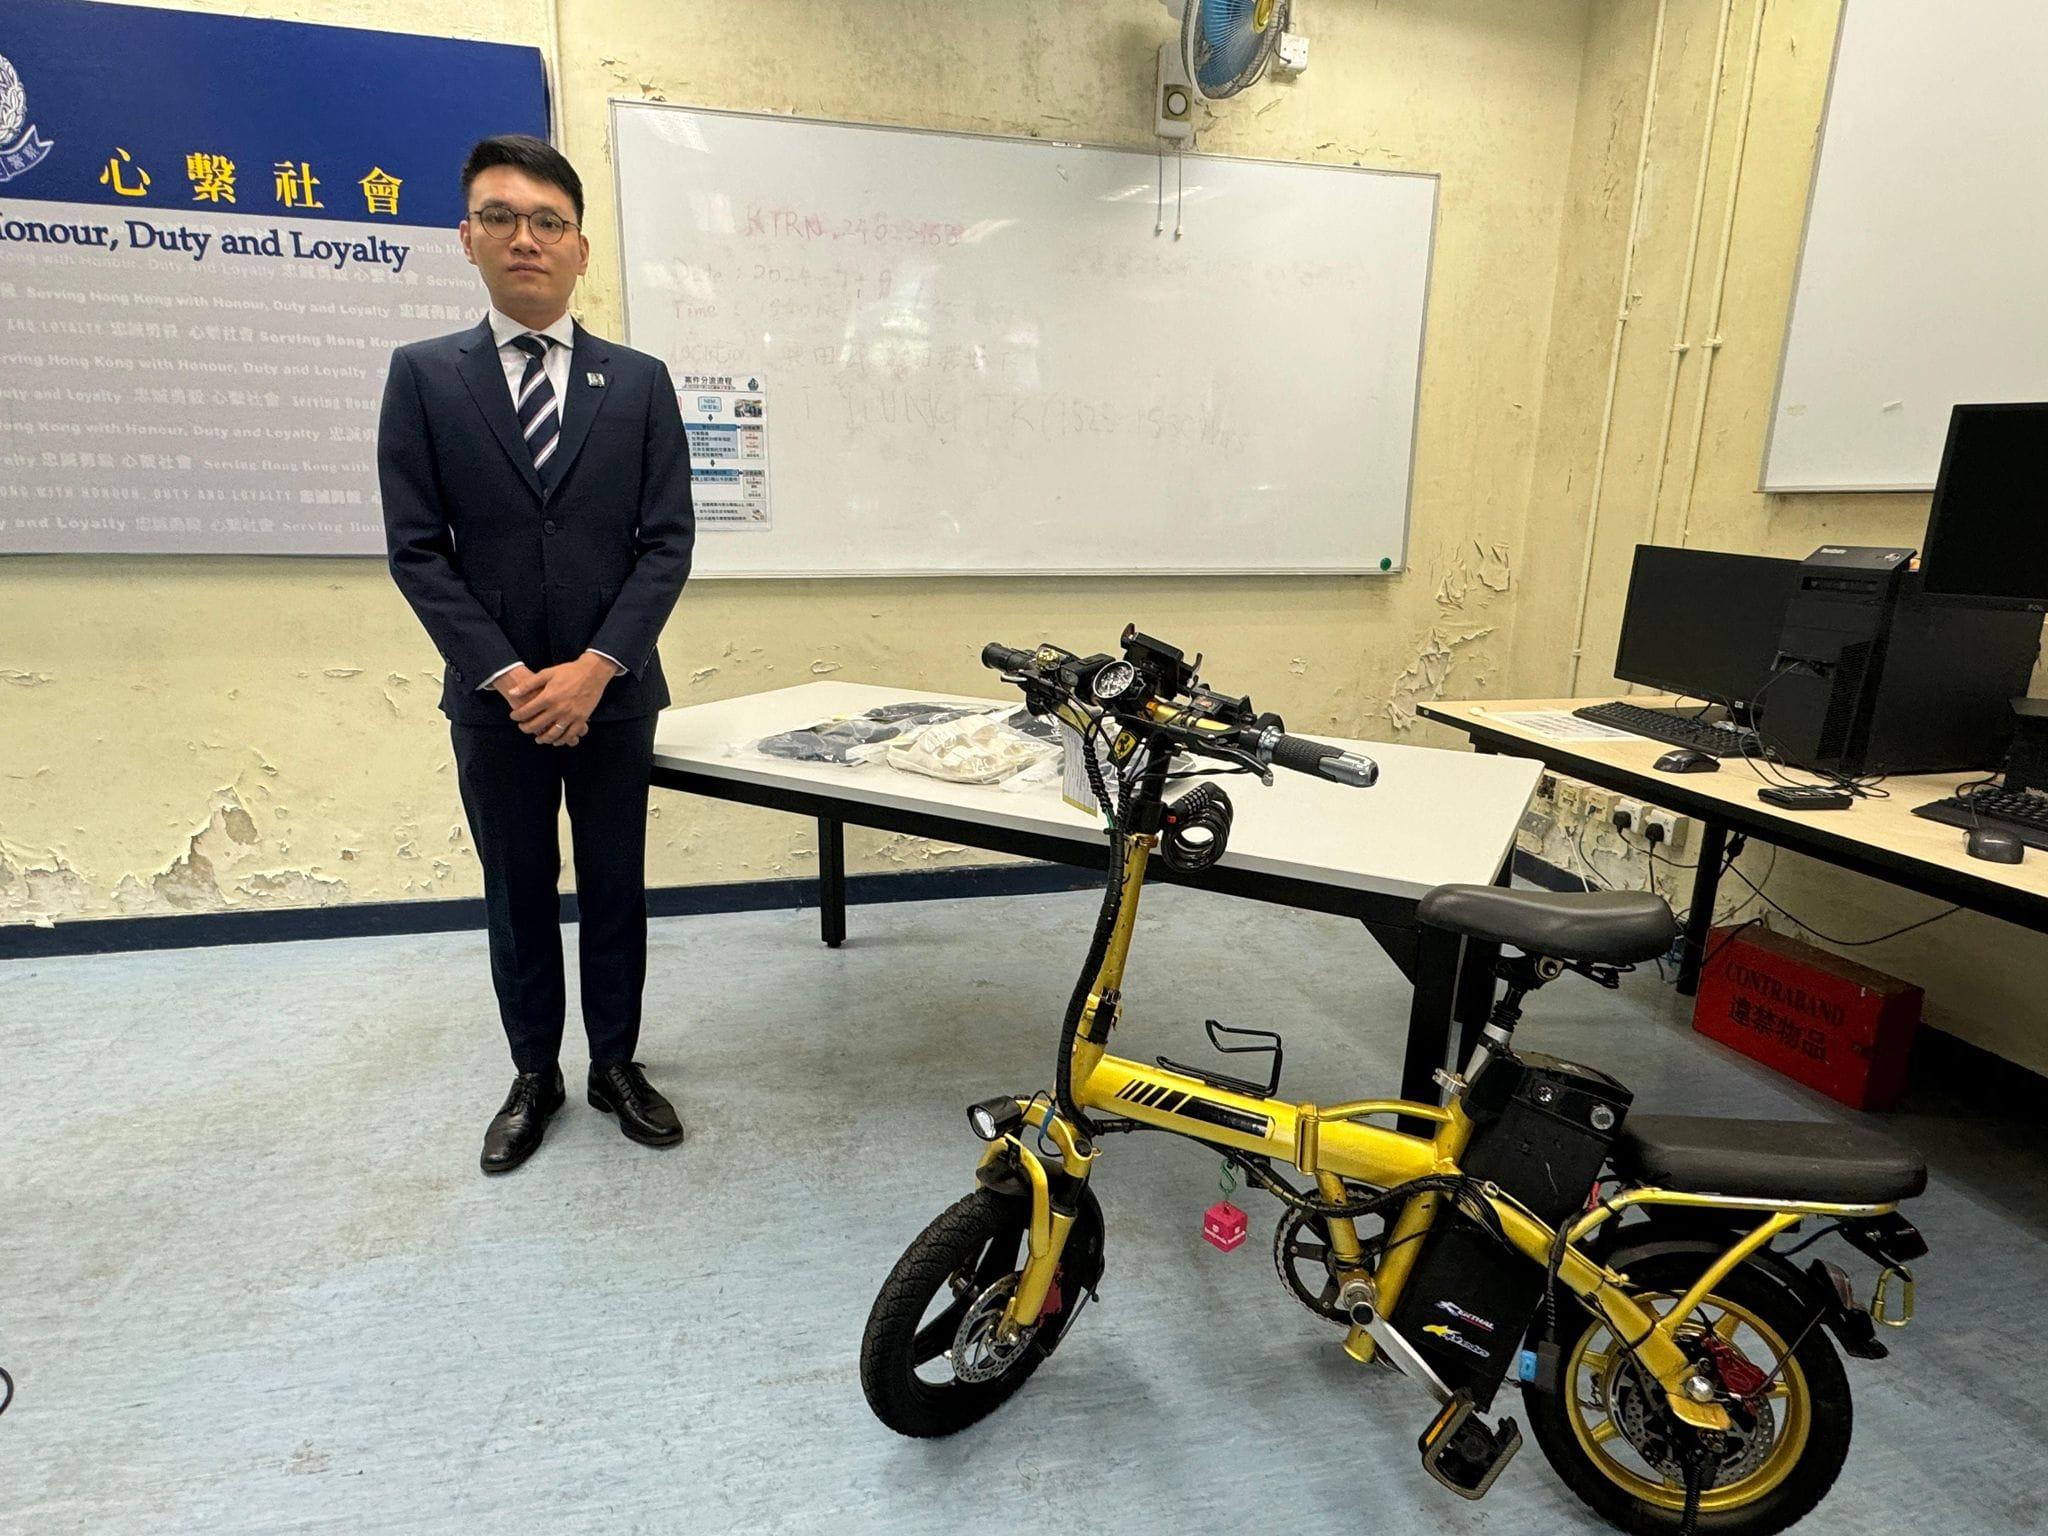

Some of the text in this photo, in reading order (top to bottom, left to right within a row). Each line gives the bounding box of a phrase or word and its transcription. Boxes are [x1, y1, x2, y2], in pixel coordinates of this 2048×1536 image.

[100, 148, 402, 214] 心繫社會
[0, 212, 410, 273] onour, Duty and Loyalty
[27, 287, 86, 304] Serving
[89, 291, 130, 305] Hong
[134, 293, 172, 308] Kong
[176, 296, 208, 307] with
[273, 300, 305, 314] Duty
[310, 302, 335, 313] and
[340, 305, 390, 318] Loyalty
[260, 330, 321, 348] Serving
[0, 353, 43, 367] rving
[48, 355, 89, 369] Hong
[94, 356, 133, 371] Kong
[139, 359, 173, 370] with
[243, 362, 278, 376] Duty
[284, 365, 309, 376] and
[315, 366, 367, 379] Loyalty
[34, 388, 61, 400] and
[67, 389, 121, 404] Loyalty
[39, 422, 81, 436] Kong
[86, 423, 120, 434] with
[193, 426, 228, 438] Duty
[234, 428, 260, 437] and
[266, 428, 320, 441] Loyalty
[15, 517, 49, 528] and
[57, 517, 125, 531] Loyalty
[1727, 963, 1845, 1026] CONTRABAND
